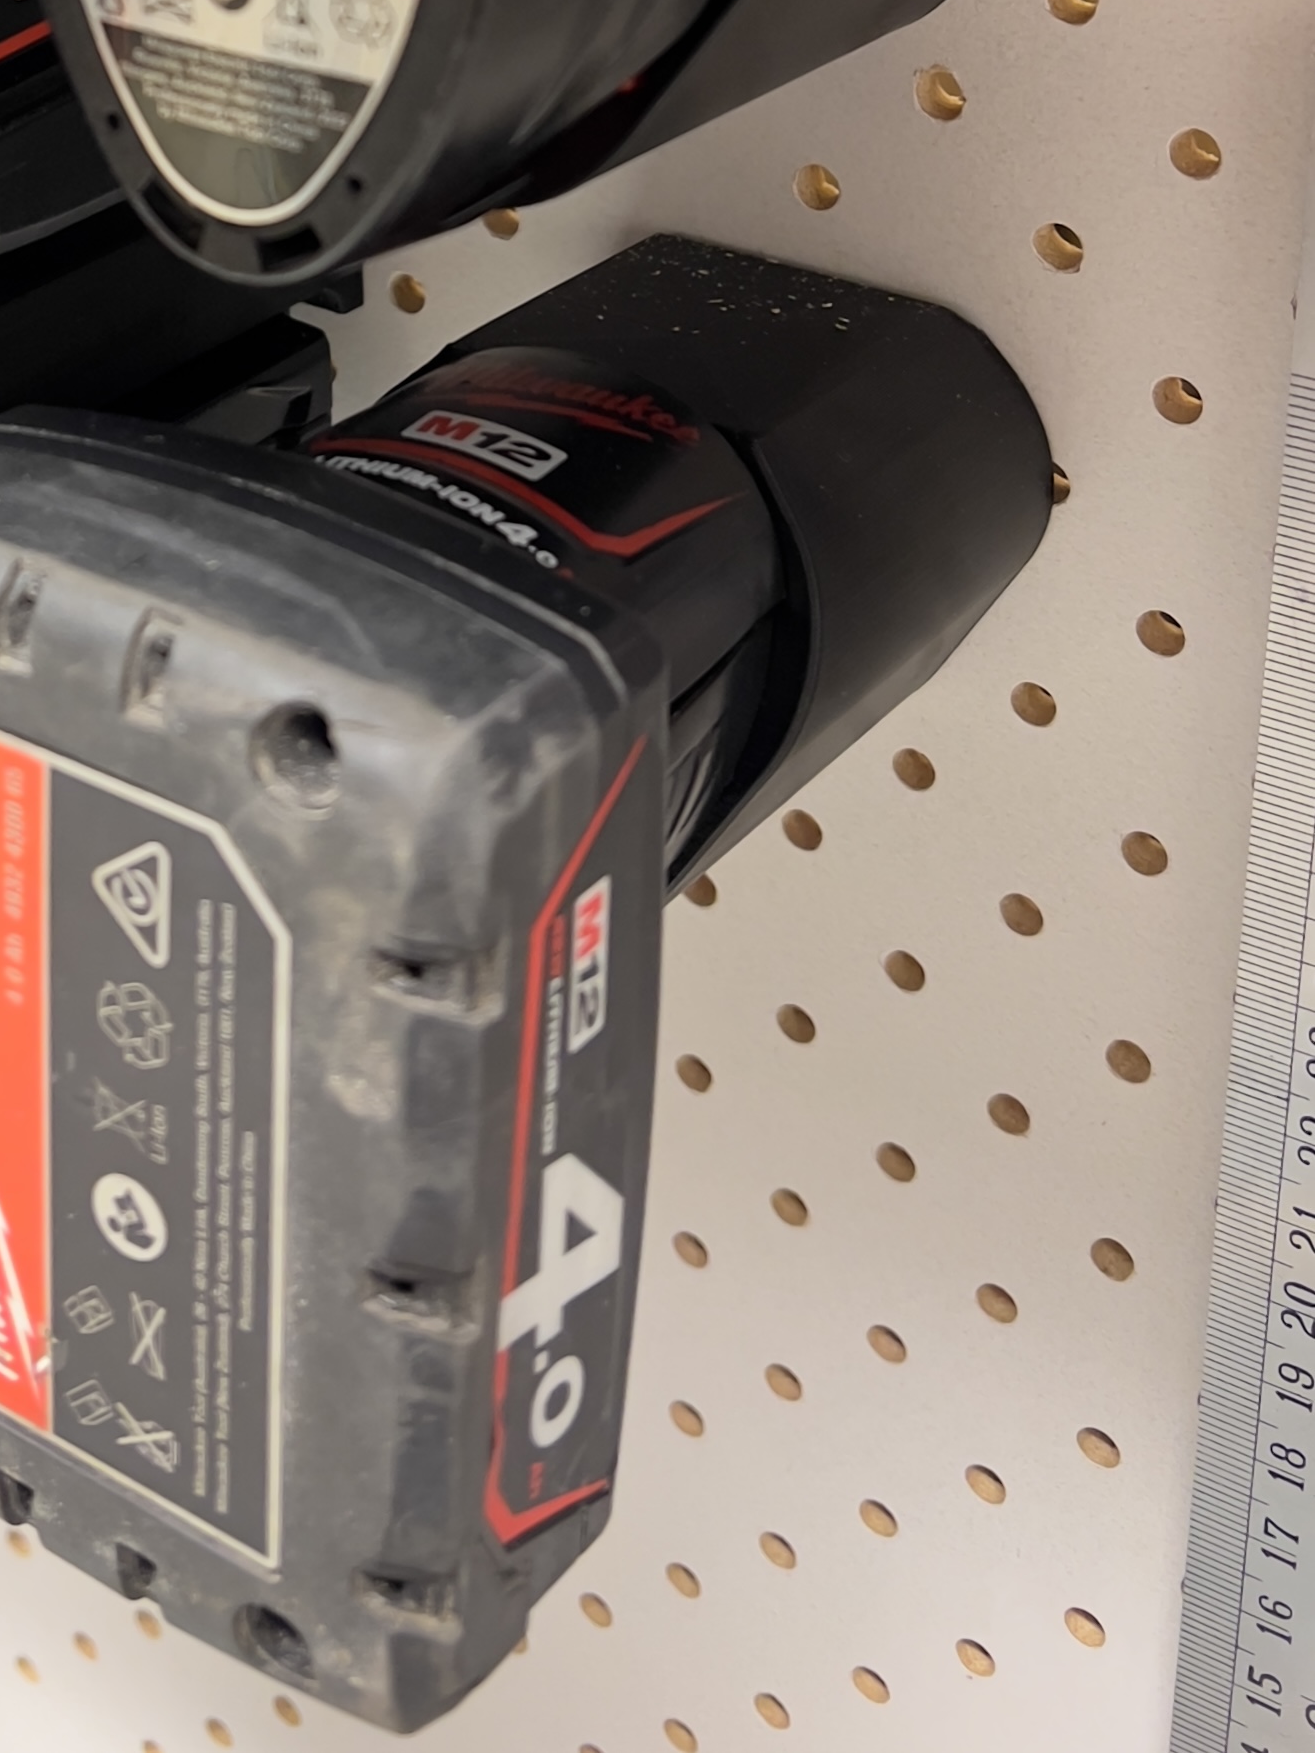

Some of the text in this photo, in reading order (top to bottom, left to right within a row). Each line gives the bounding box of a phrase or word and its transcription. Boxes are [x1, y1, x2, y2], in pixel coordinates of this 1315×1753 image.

[417, 414, 553, 470] M12
[1275, 1362, 1315, 1413] 19
[1267, 1442, 1307, 1492] 18
[1261, 1516, 1300, 1571] 17
[1256, 1593, 1293, 1645] 16
[1245, 1664, 1283, 1718] 15
